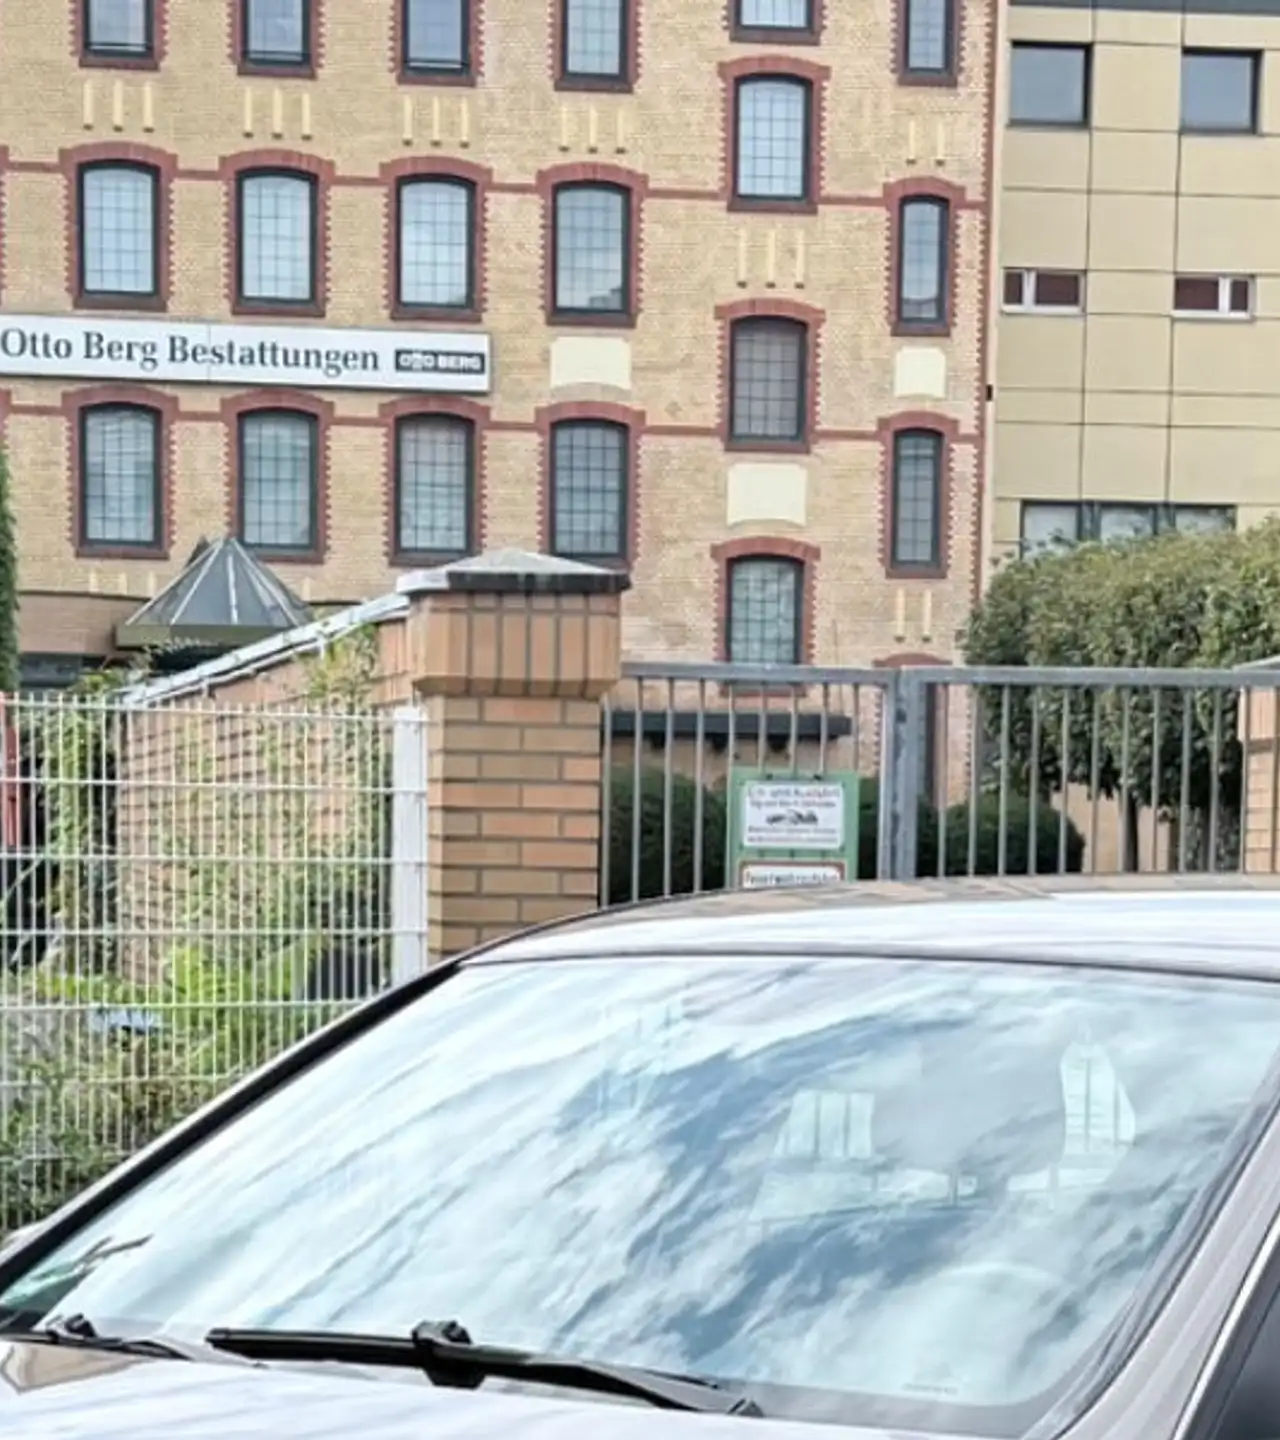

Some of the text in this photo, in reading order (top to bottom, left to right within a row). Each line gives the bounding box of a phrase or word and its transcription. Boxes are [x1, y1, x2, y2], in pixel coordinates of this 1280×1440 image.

[0, 327, 380, 378] Otto Berg Bestattungen
